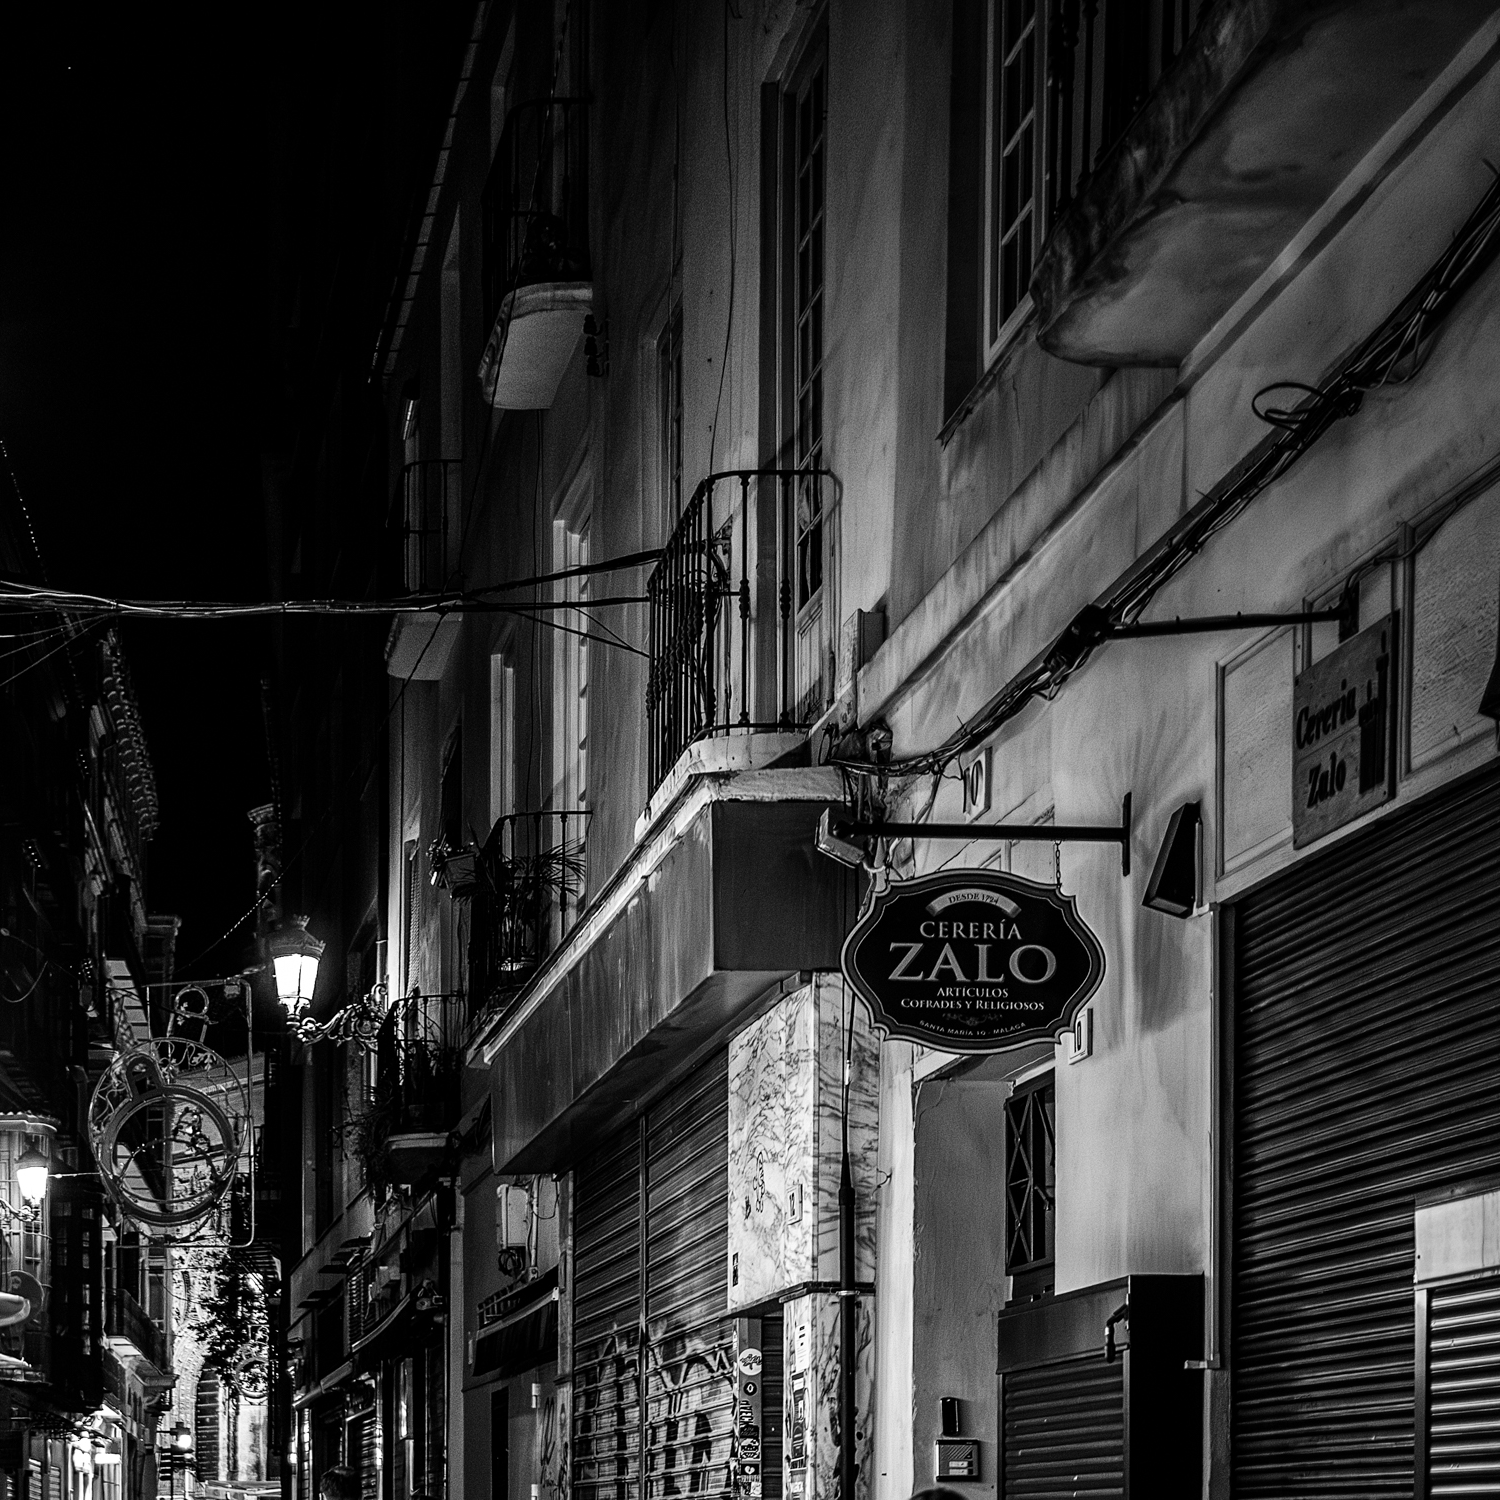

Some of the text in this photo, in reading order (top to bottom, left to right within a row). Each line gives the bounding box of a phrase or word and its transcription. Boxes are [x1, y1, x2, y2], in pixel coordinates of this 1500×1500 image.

[963, 759, 981, 813] 10
[1306, 751, 1347, 809] Zalo
[948, 893, 999, 906] DESDE 1724
[919, 918, 1022, 940] CERERÍA
[887, 942, 1057, 984] ZALO
[936, 985, 1009, 998] ARTÍCULOS
[965, 1000, 973, 1010] Y
[919, 1020, 945, 1033] SANTA
